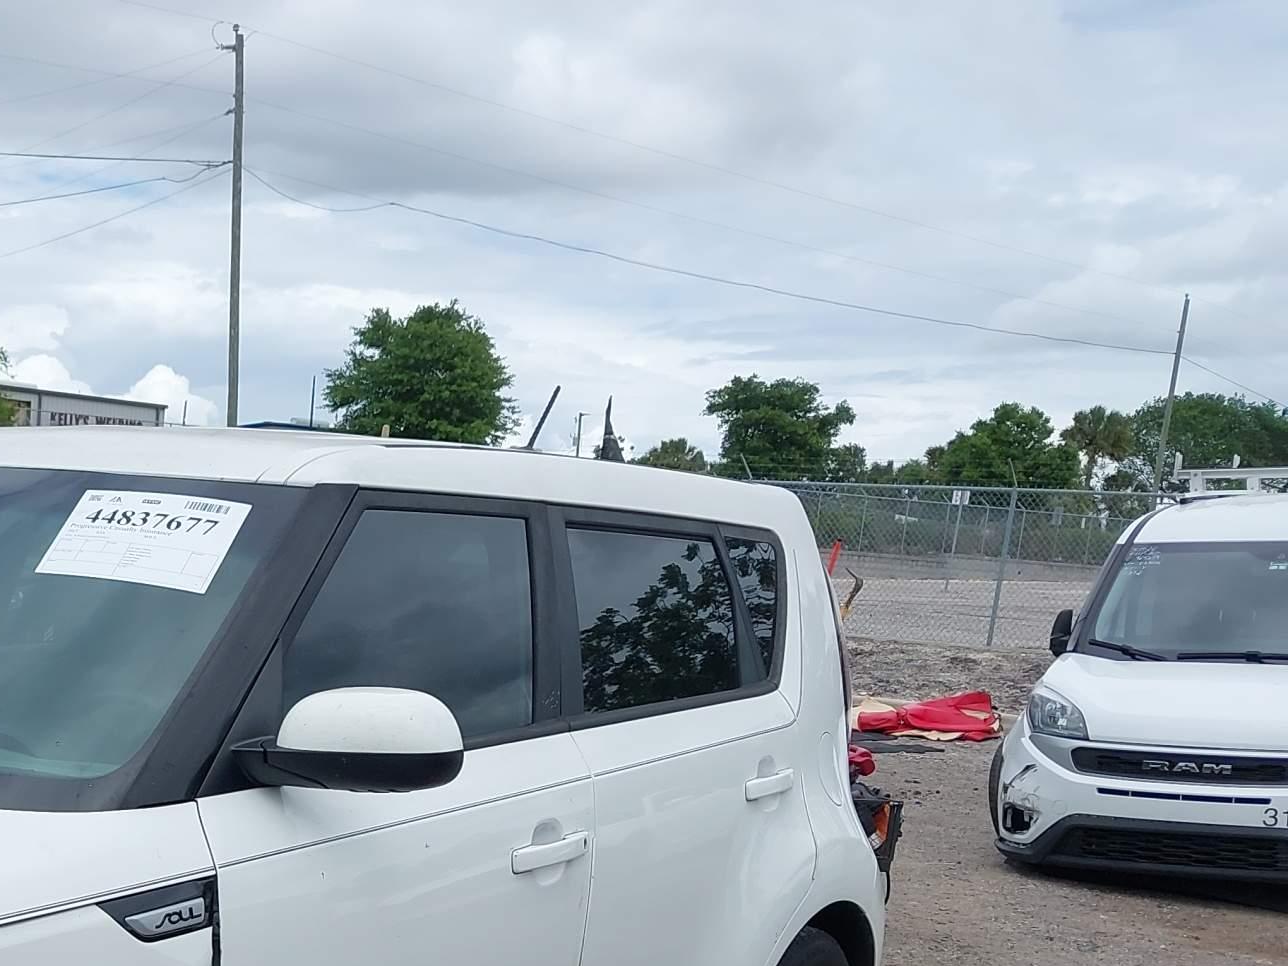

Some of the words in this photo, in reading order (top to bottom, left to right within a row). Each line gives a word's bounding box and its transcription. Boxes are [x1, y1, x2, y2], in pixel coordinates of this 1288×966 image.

[85, 508, 220, 535] 44837677
[1142, 760, 1232, 774] RAM
[155, 907, 202, 929] SOUL
